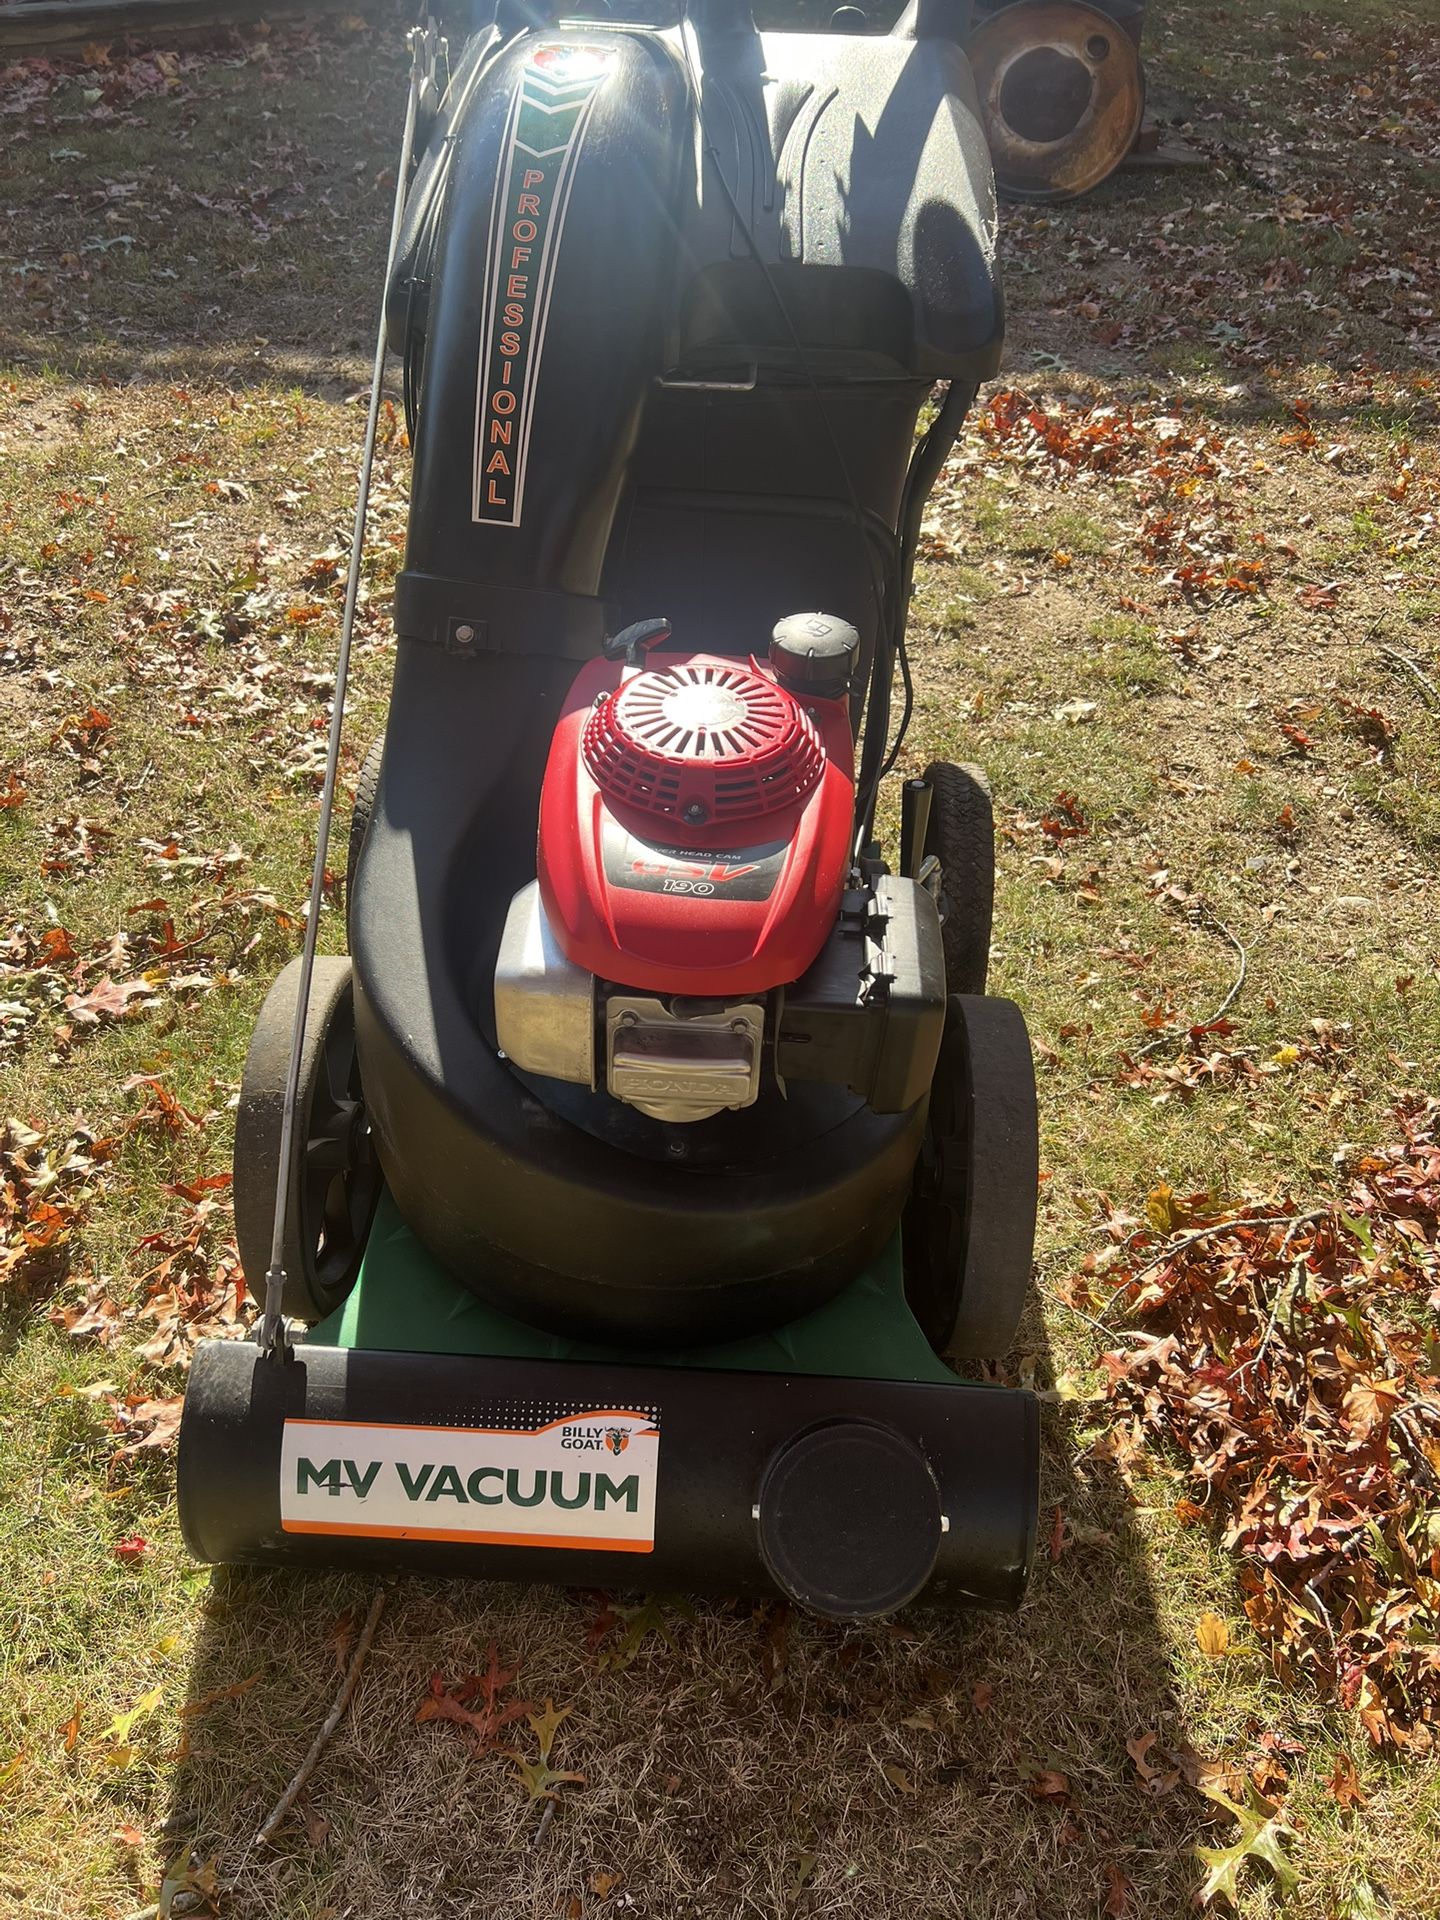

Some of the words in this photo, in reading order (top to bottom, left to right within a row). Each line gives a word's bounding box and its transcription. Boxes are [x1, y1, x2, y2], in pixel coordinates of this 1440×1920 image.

[485, 169, 544, 505] PROFESSIONAL
[680, 850, 712, 858] HEAD
[662, 879, 715, 895] 190
[622, 1078, 739, 1095] HONDA
[562, 1426, 603, 1438] BILLY
[296, 1457, 383, 1498] MV
[395, 1461, 640, 1513] VACUUM
